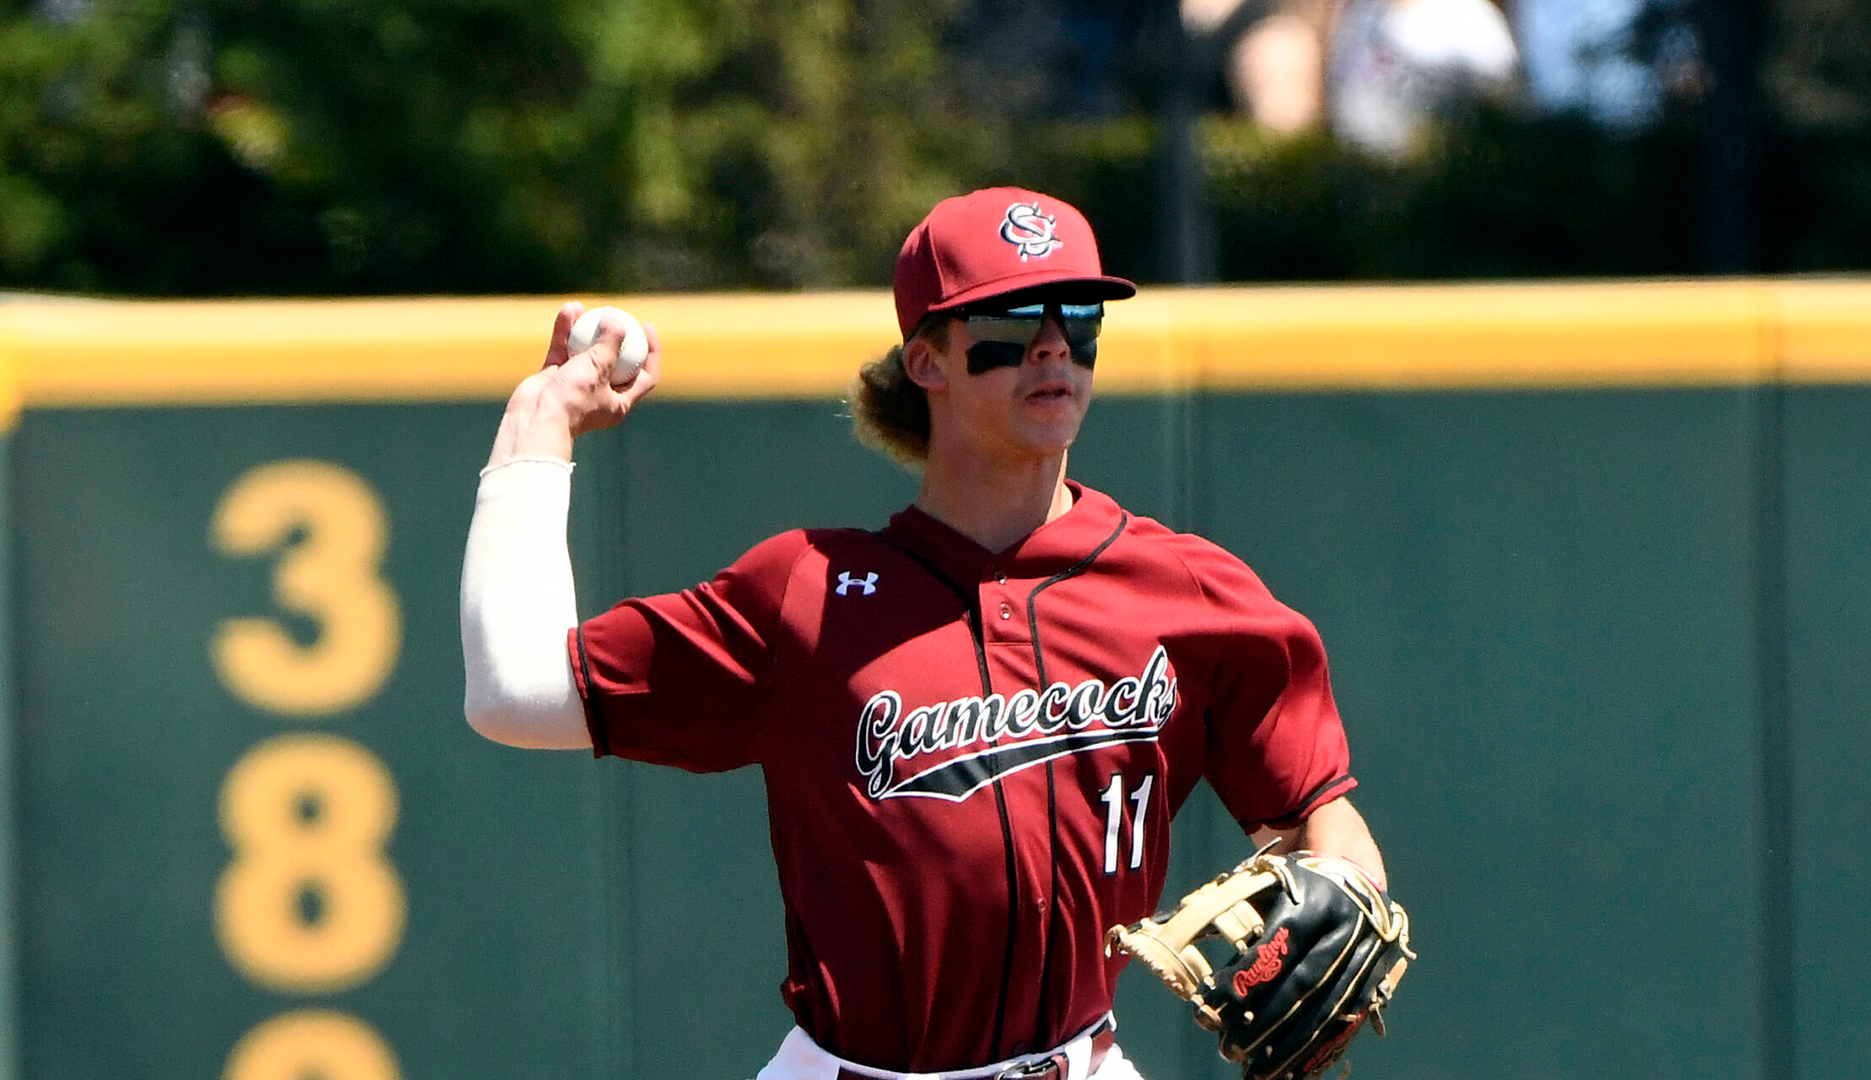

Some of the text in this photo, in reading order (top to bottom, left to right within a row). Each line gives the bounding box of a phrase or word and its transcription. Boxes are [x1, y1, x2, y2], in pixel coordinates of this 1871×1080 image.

[856, 645, 1177, 799] Gamecocks
[1099, 771, 1154, 874] 11
[1233, 927, 1289, 997] Rawlings
